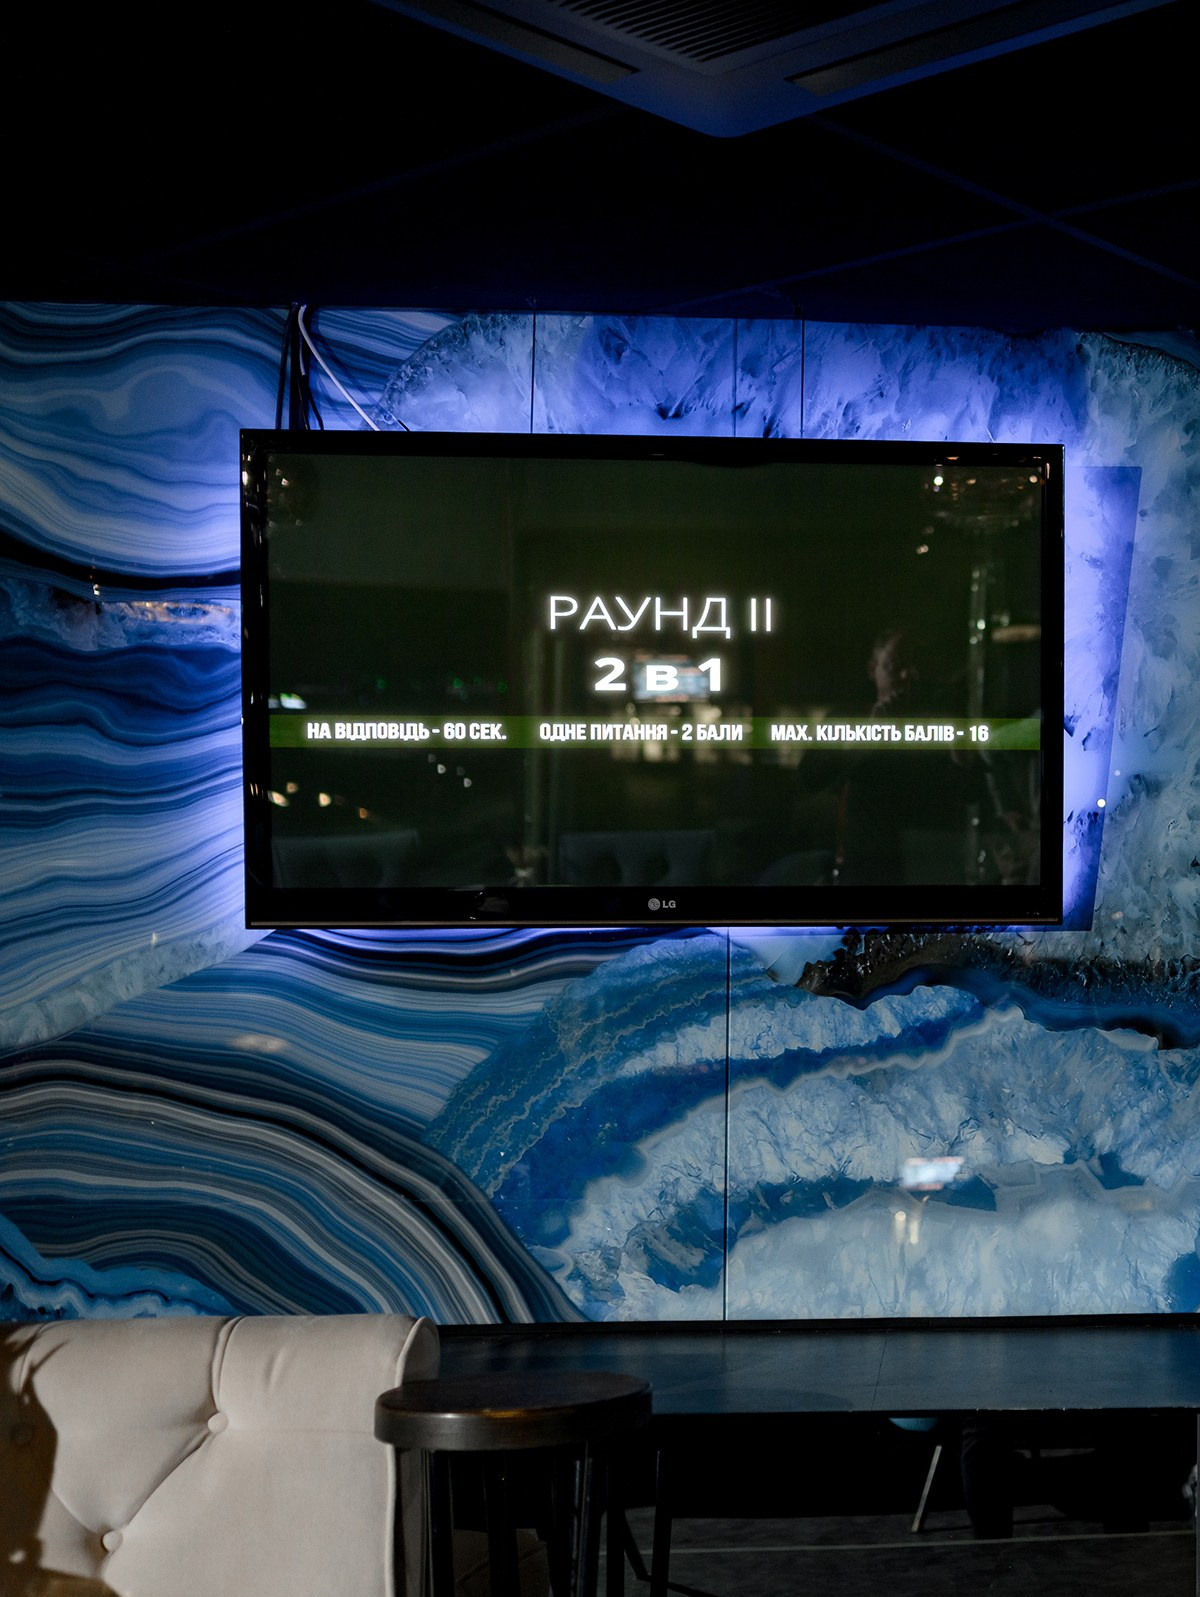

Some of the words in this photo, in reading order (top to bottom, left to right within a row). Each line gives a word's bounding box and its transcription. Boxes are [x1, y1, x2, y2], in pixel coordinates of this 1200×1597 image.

[549, 595, 731, 639] РАУНД
[594, 656, 627, 692] 2
[645, 664, 680, 692] в
[697, 657, 721, 692] 1
[307, 722, 332, 740] НА
[334, 722, 430, 741] ВІДПОВІДЬ
[443, 723, 466, 740] 60
[469, 723, 508, 740] СЕК.
[539, 723, 587, 742] ОДНЕ
[590, 723, 668, 741] ПИТАННЯ
[682, 724, 693, 741] 2
[696, 724, 744, 741] БАЛИ
[816, 725, 902, 742] КІЛЬКІСТЬ
[904, 725, 955, 742] БАЛІВ
[969, 725, 990, 742] 16
[662, 900, 677, 909] LG
